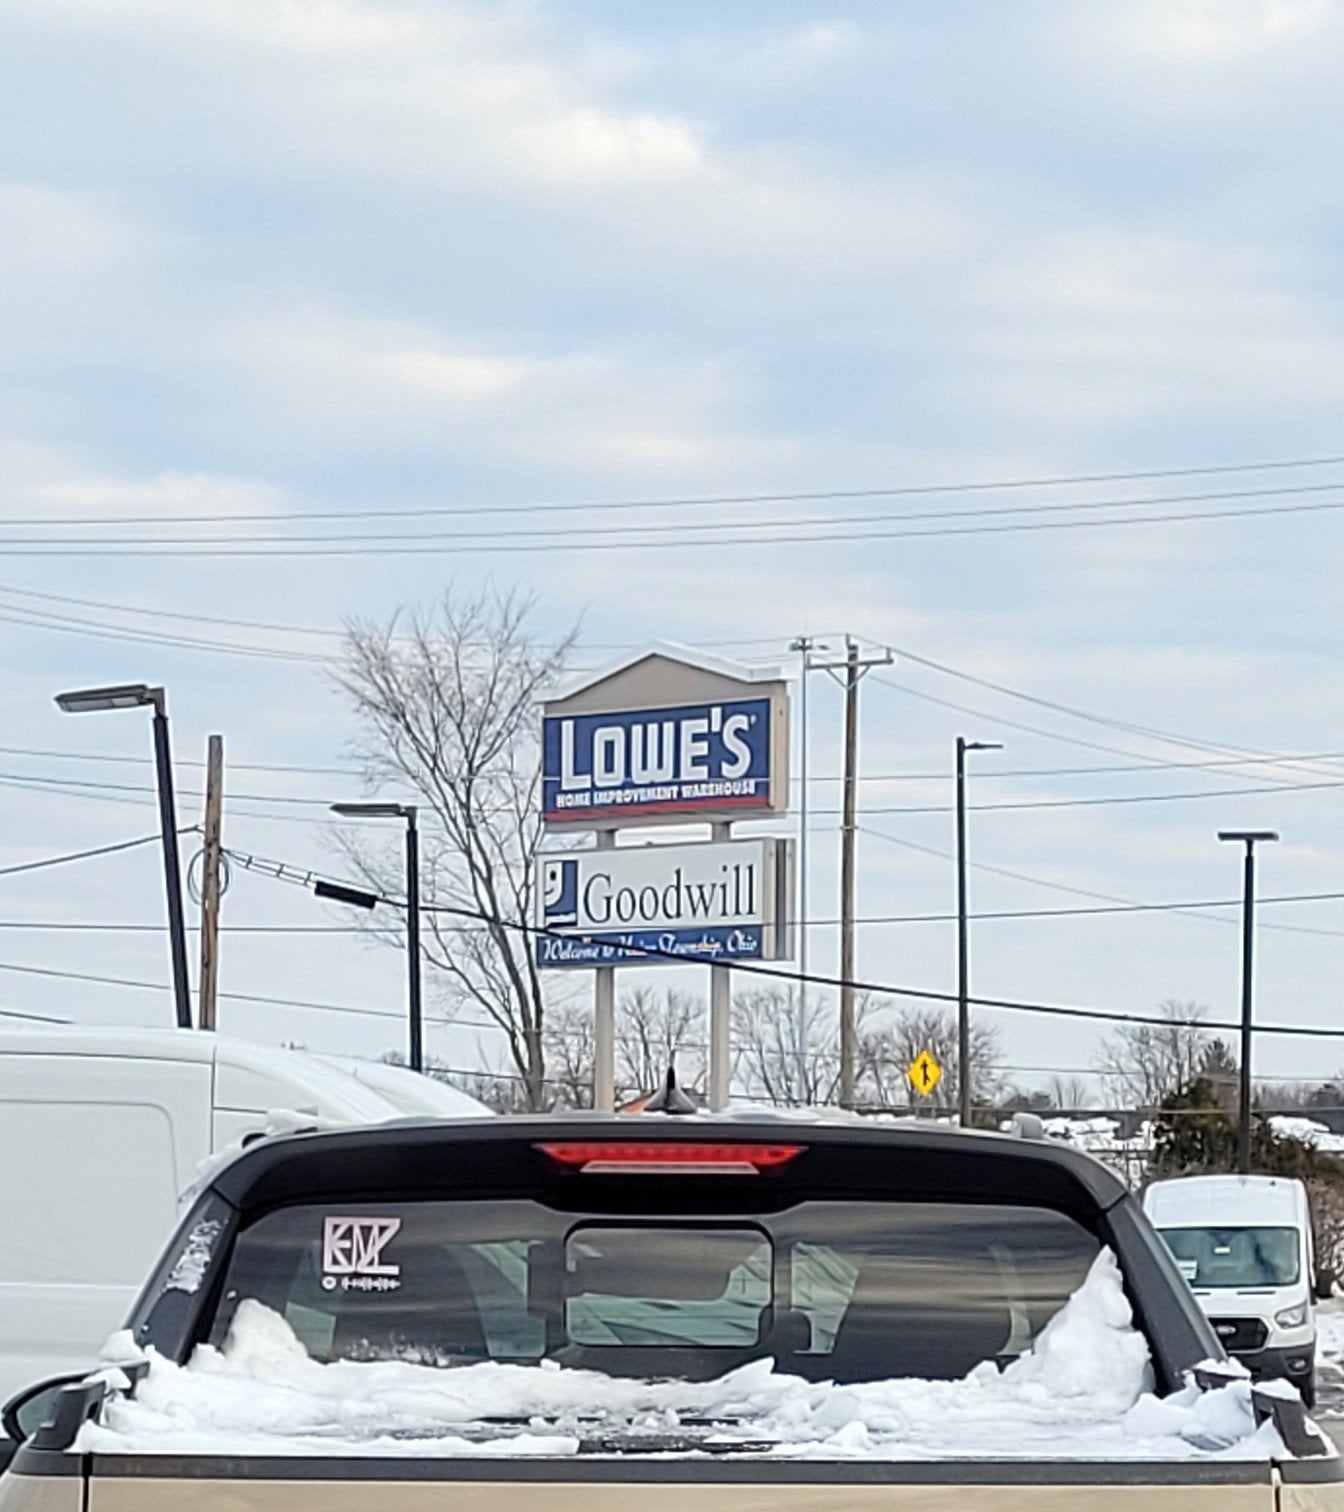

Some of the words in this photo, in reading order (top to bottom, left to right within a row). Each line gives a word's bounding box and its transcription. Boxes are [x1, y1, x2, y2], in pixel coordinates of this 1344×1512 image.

[561, 707, 753, 790] LOWE'S
[556, 791, 591, 808] HOME
[593, 785, 679, 805] IMPROVEMENT
[681, 779, 756, 800] WAREHOUSE
[583, 864, 757, 924] Goodwill
